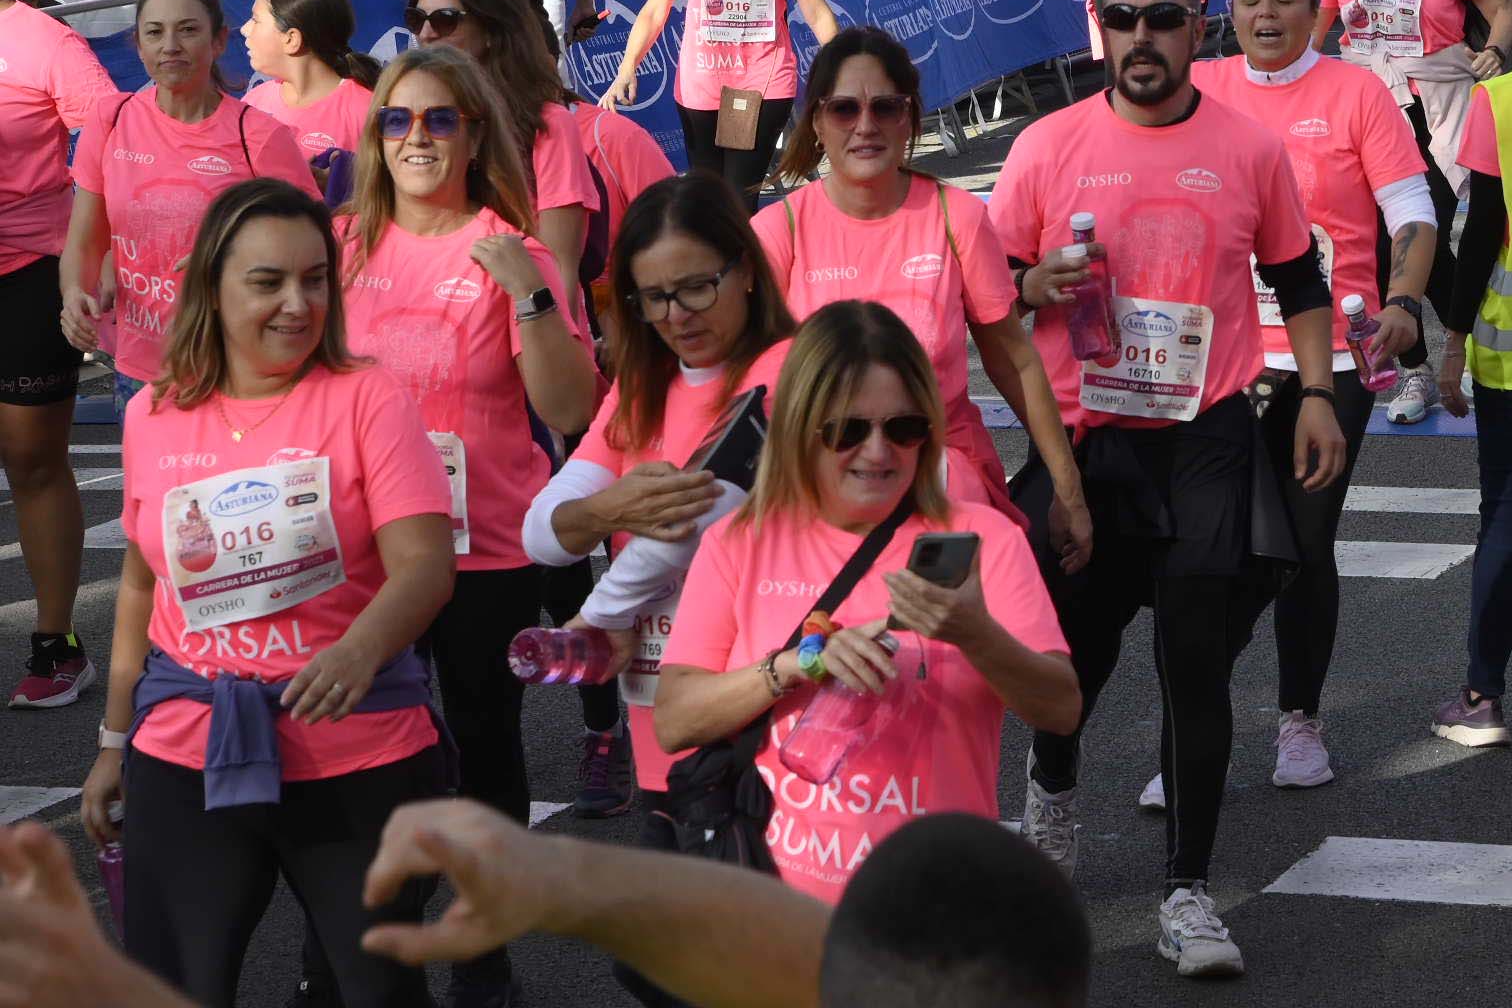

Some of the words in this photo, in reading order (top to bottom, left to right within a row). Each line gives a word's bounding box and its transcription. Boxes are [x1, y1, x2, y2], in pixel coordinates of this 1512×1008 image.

[726, 1, 751, 12] 016
[1371, 11, 1393, 24] 016
[696, 52, 744, 69] SUMA
[1077, 173, 1132, 188] OYSHO
[111, 235, 137, 261] TU
[805, 267, 858, 282] OYSHO
[119, 268, 177, 303] DORS
[1125, 345, 1168, 365] 016
[1127, 367, 1161, 380] 16710
[159, 452, 217, 469] OYSHO
[215, 490, 274, 513] ASTURIANA
[221, 521, 274, 552] 016
[239, 551, 264, 568] 767
[196, 578, 240, 595] CARRERA
[241, 574, 254, 584] DE
[255, 570, 267, 581] LA
[198, 597, 246, 618] OYSHO
